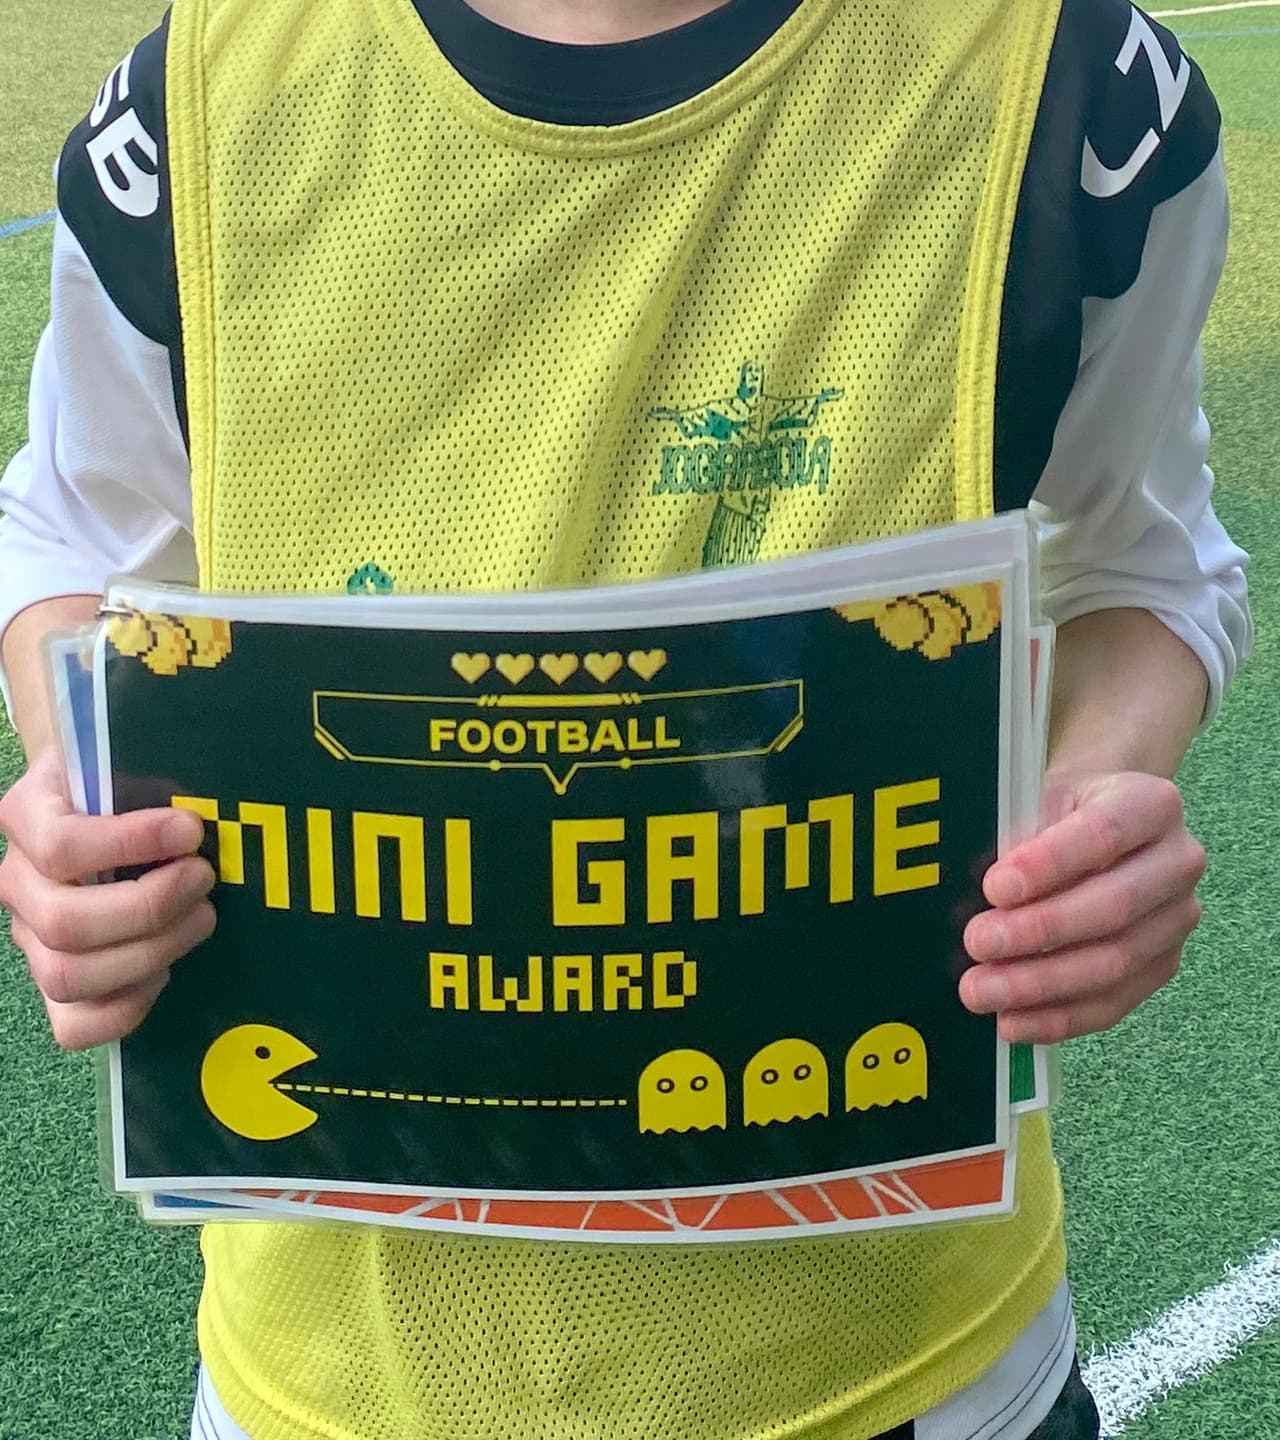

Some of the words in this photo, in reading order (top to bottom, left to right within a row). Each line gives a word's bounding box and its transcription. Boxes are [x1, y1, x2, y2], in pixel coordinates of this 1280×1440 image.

[429, 715, 682, 755] FOOTBALL
[171, 794, 473, 926] MINI
[551, 777, 941, 927] GAME
[428, 951, 697, 1012] AWARD
